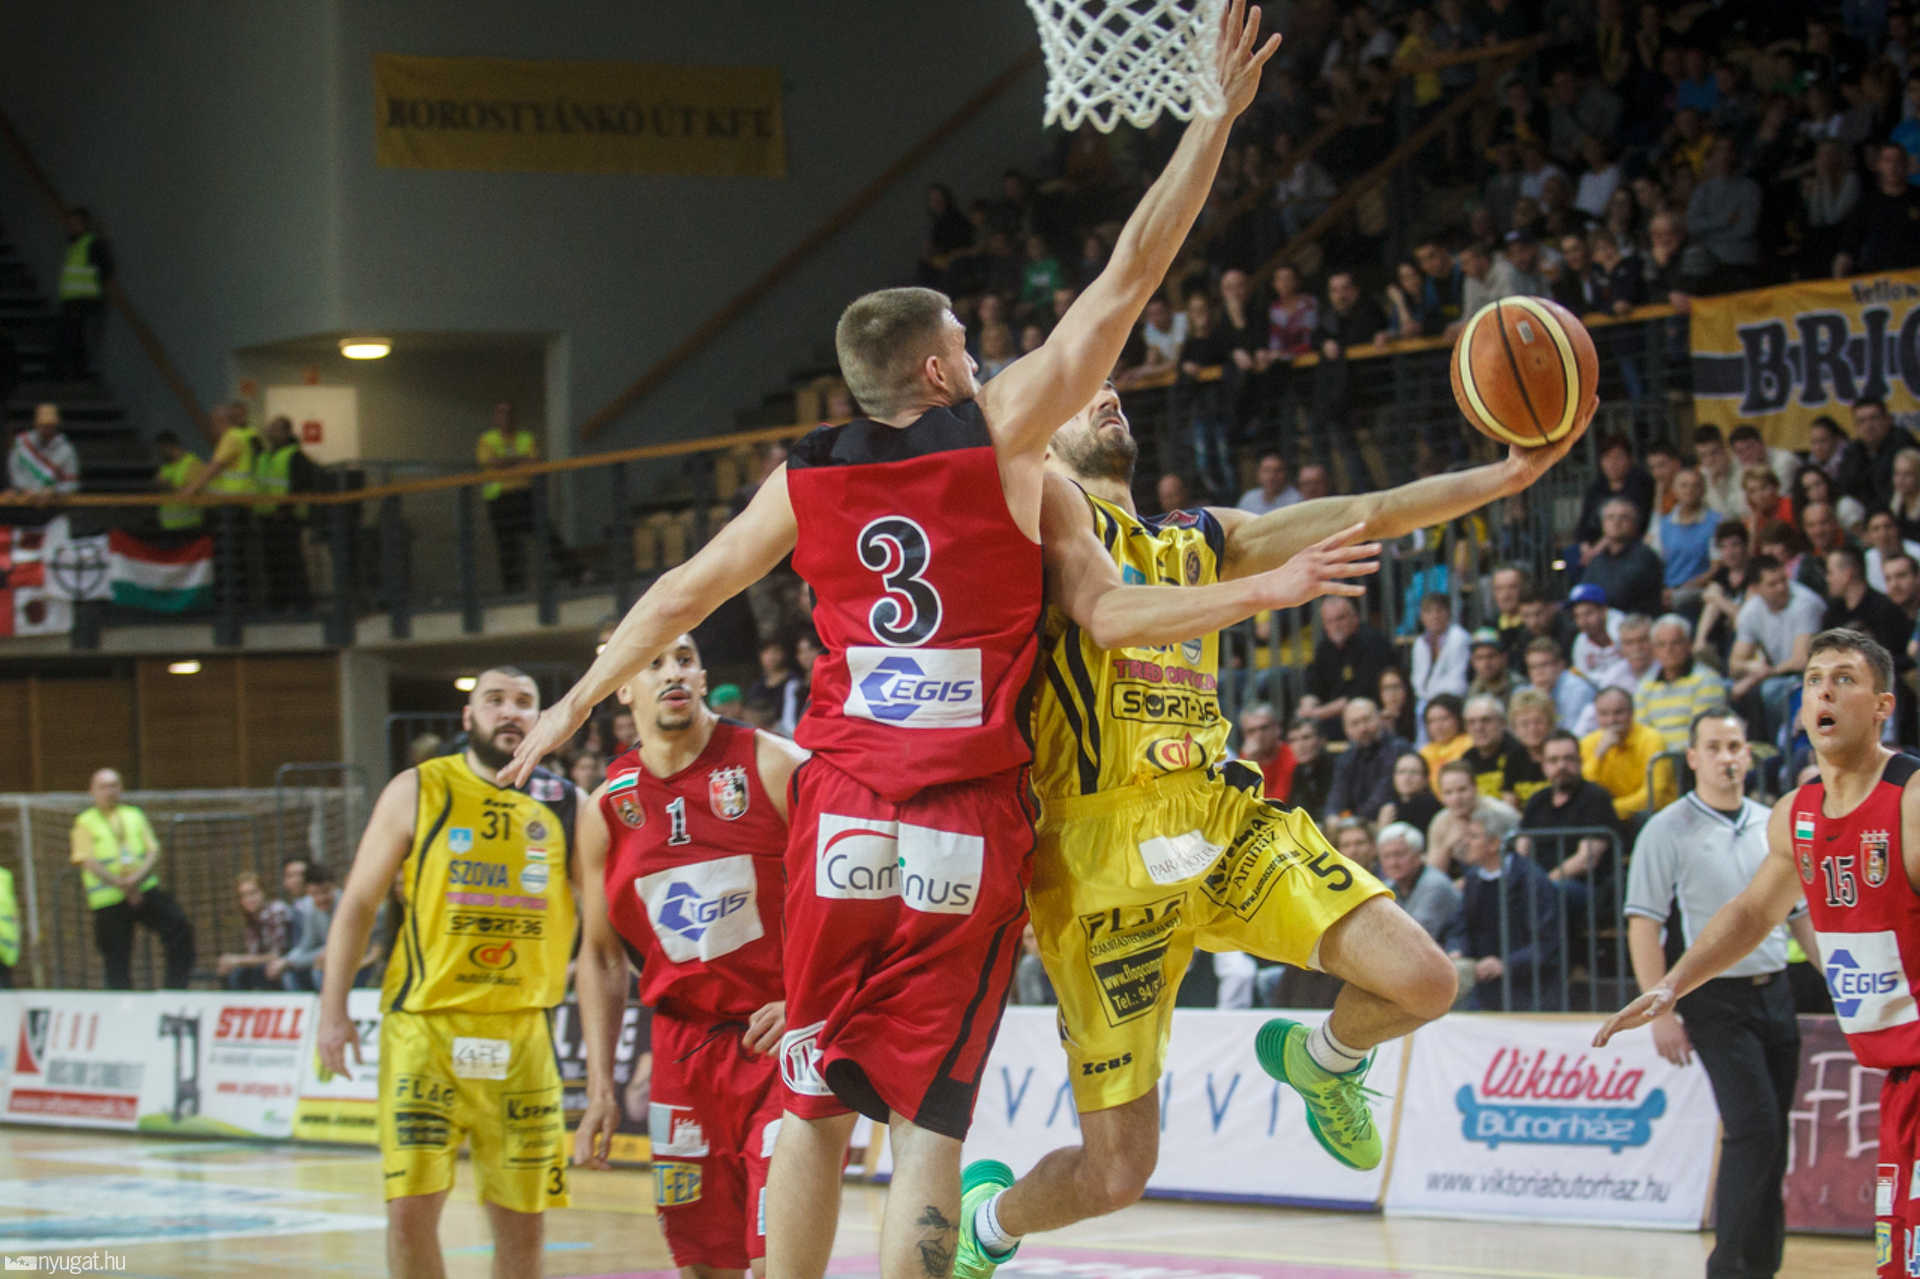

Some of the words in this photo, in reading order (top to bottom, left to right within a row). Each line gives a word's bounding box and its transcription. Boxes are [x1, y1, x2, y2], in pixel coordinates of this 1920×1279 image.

[857, 515, 942, 648] 3
[891, 680, 975, 703] EGIS
[481, 810, 511, 841] 31
[666, 796, 693, 847] 1
[447, 859, 510, 889] SZOVA
[1308, 851, 1354, 893] 5
[1821, 854, 1860, 908] 15
[1841, 969, 1899, 996] EGIS
[213, 1006, 305, 1041] STOLL
[1479, 1046, 1646, 1102] Viktória
[1476, 1108, 1637, 1142] Bútorház
[546, 1166, 565, 1196] 3
[1425, 1169, 1672, 1204] www.viktoriabutorhaz.hu
